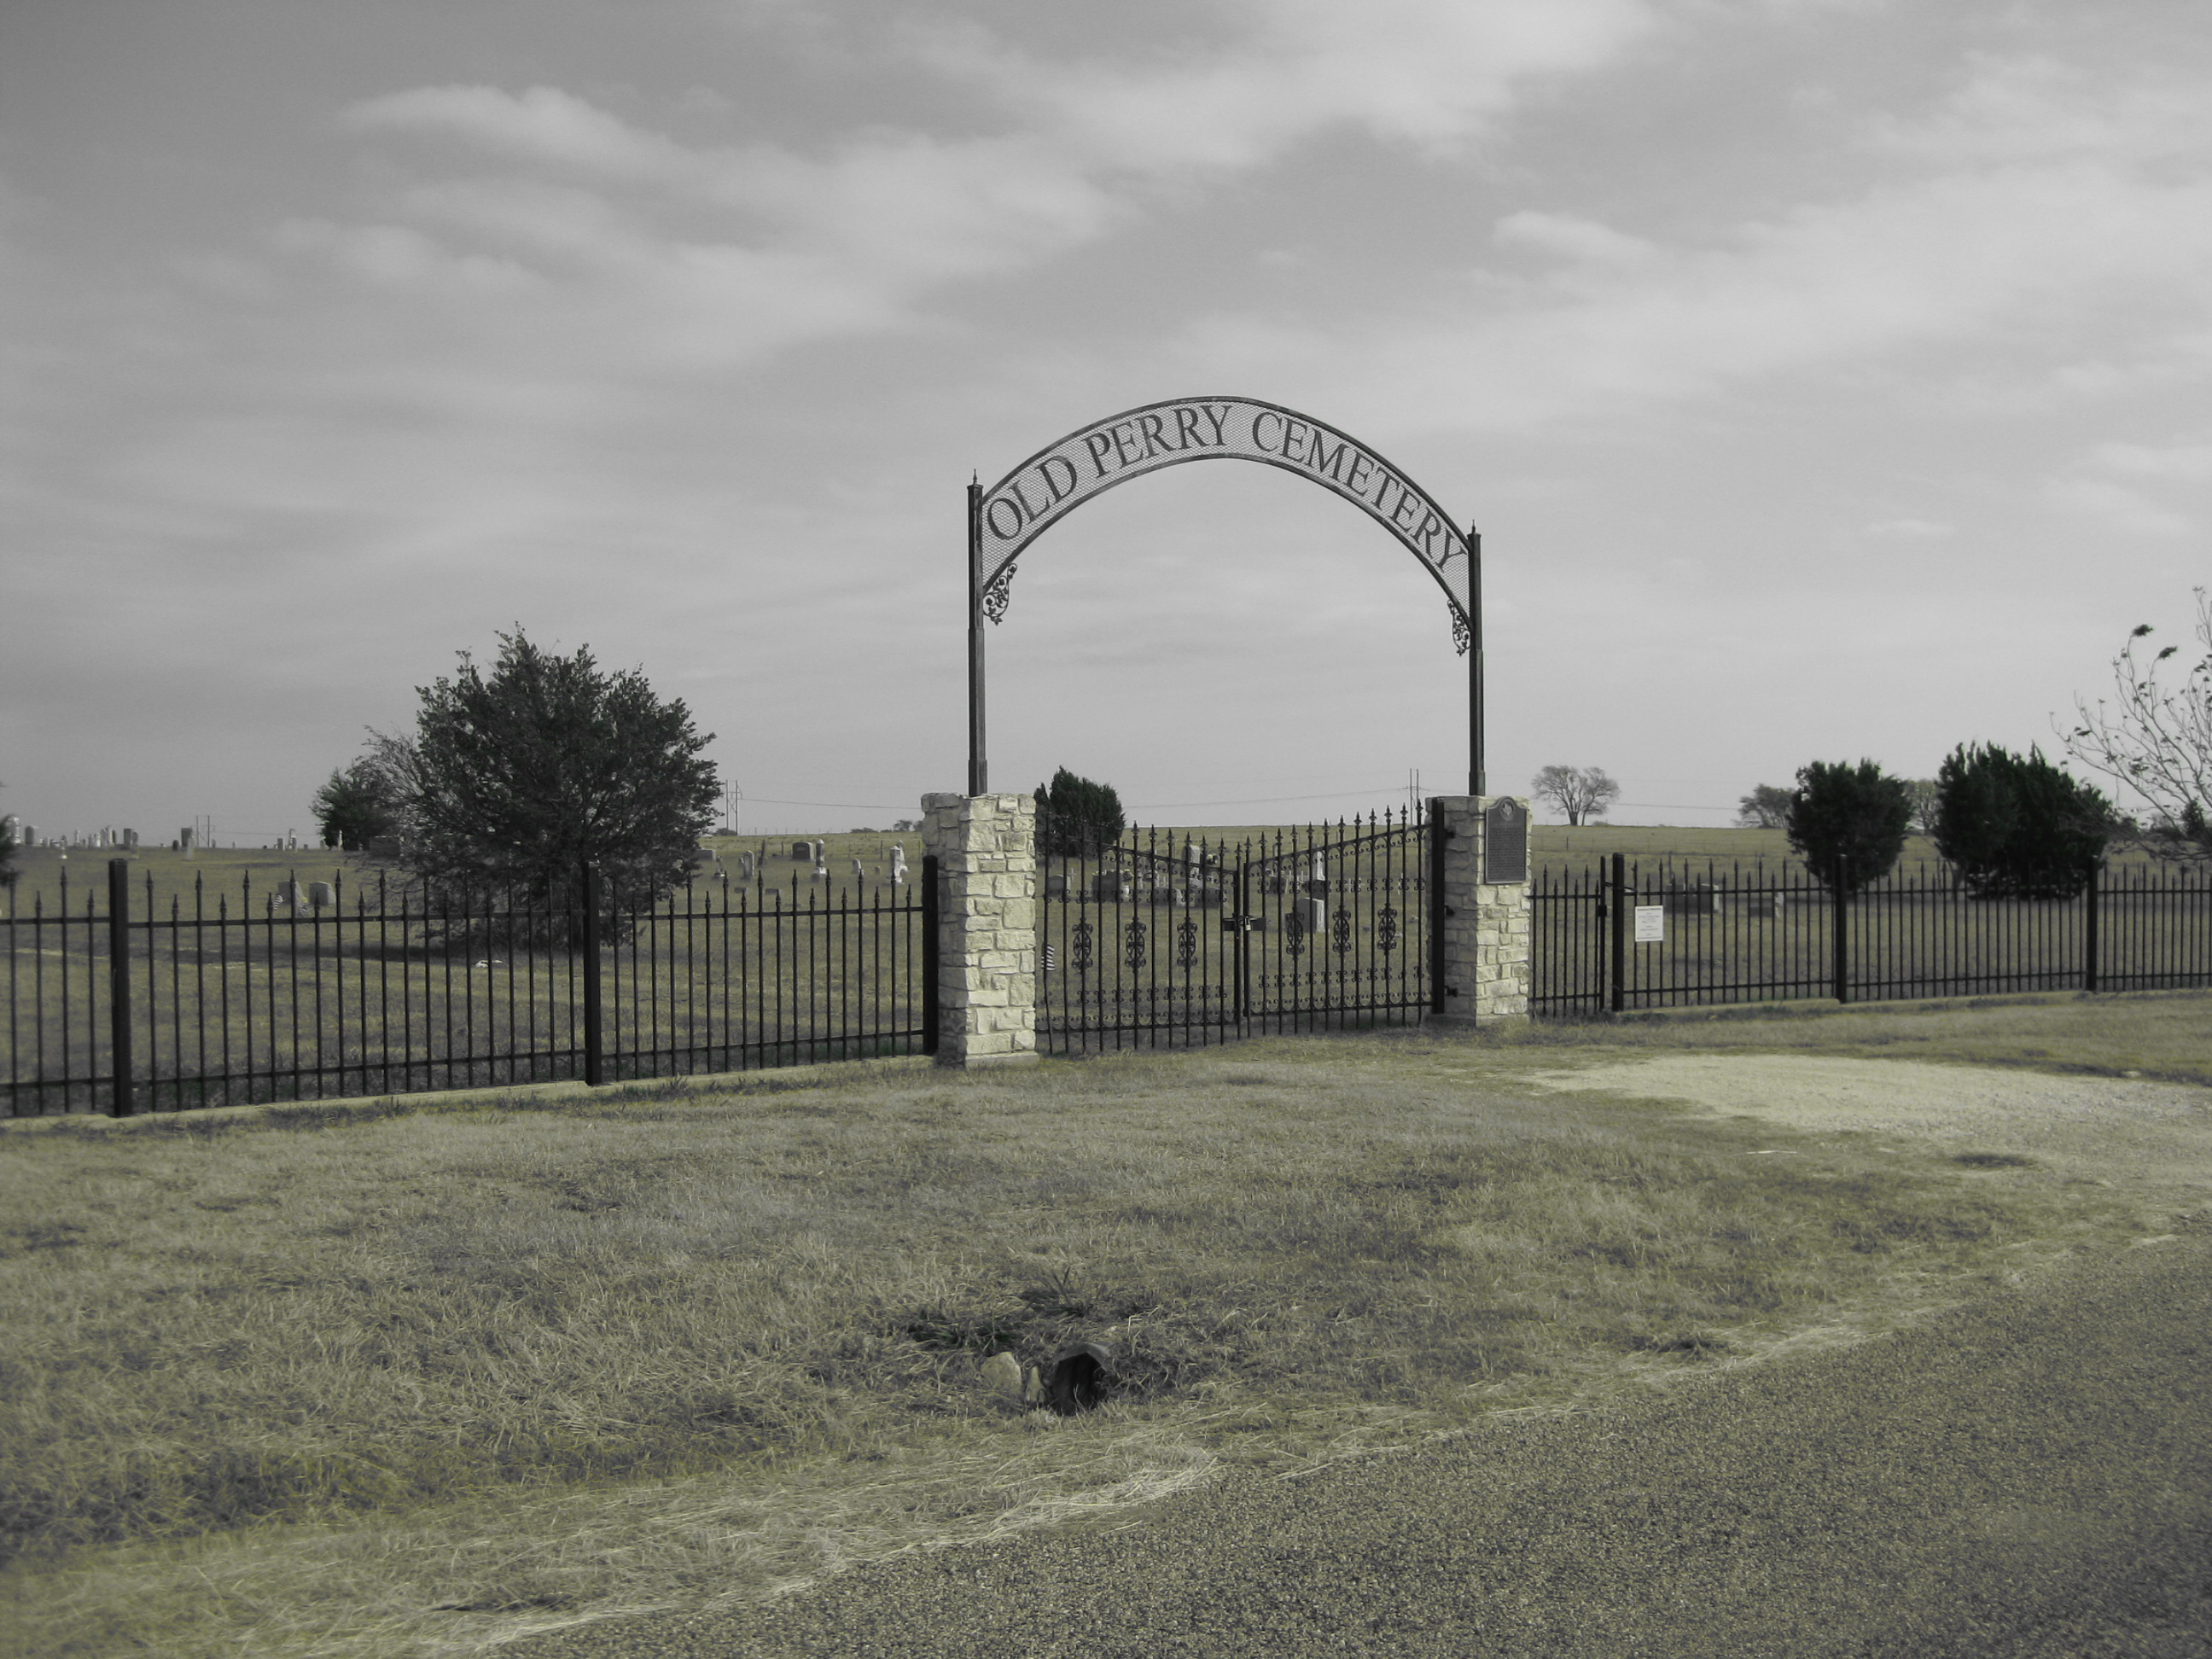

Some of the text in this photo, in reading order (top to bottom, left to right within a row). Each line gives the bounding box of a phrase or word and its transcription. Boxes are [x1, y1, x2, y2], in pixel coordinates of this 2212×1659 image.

[987, 405, 1467, 572] OLD PERRY CEMETERY
